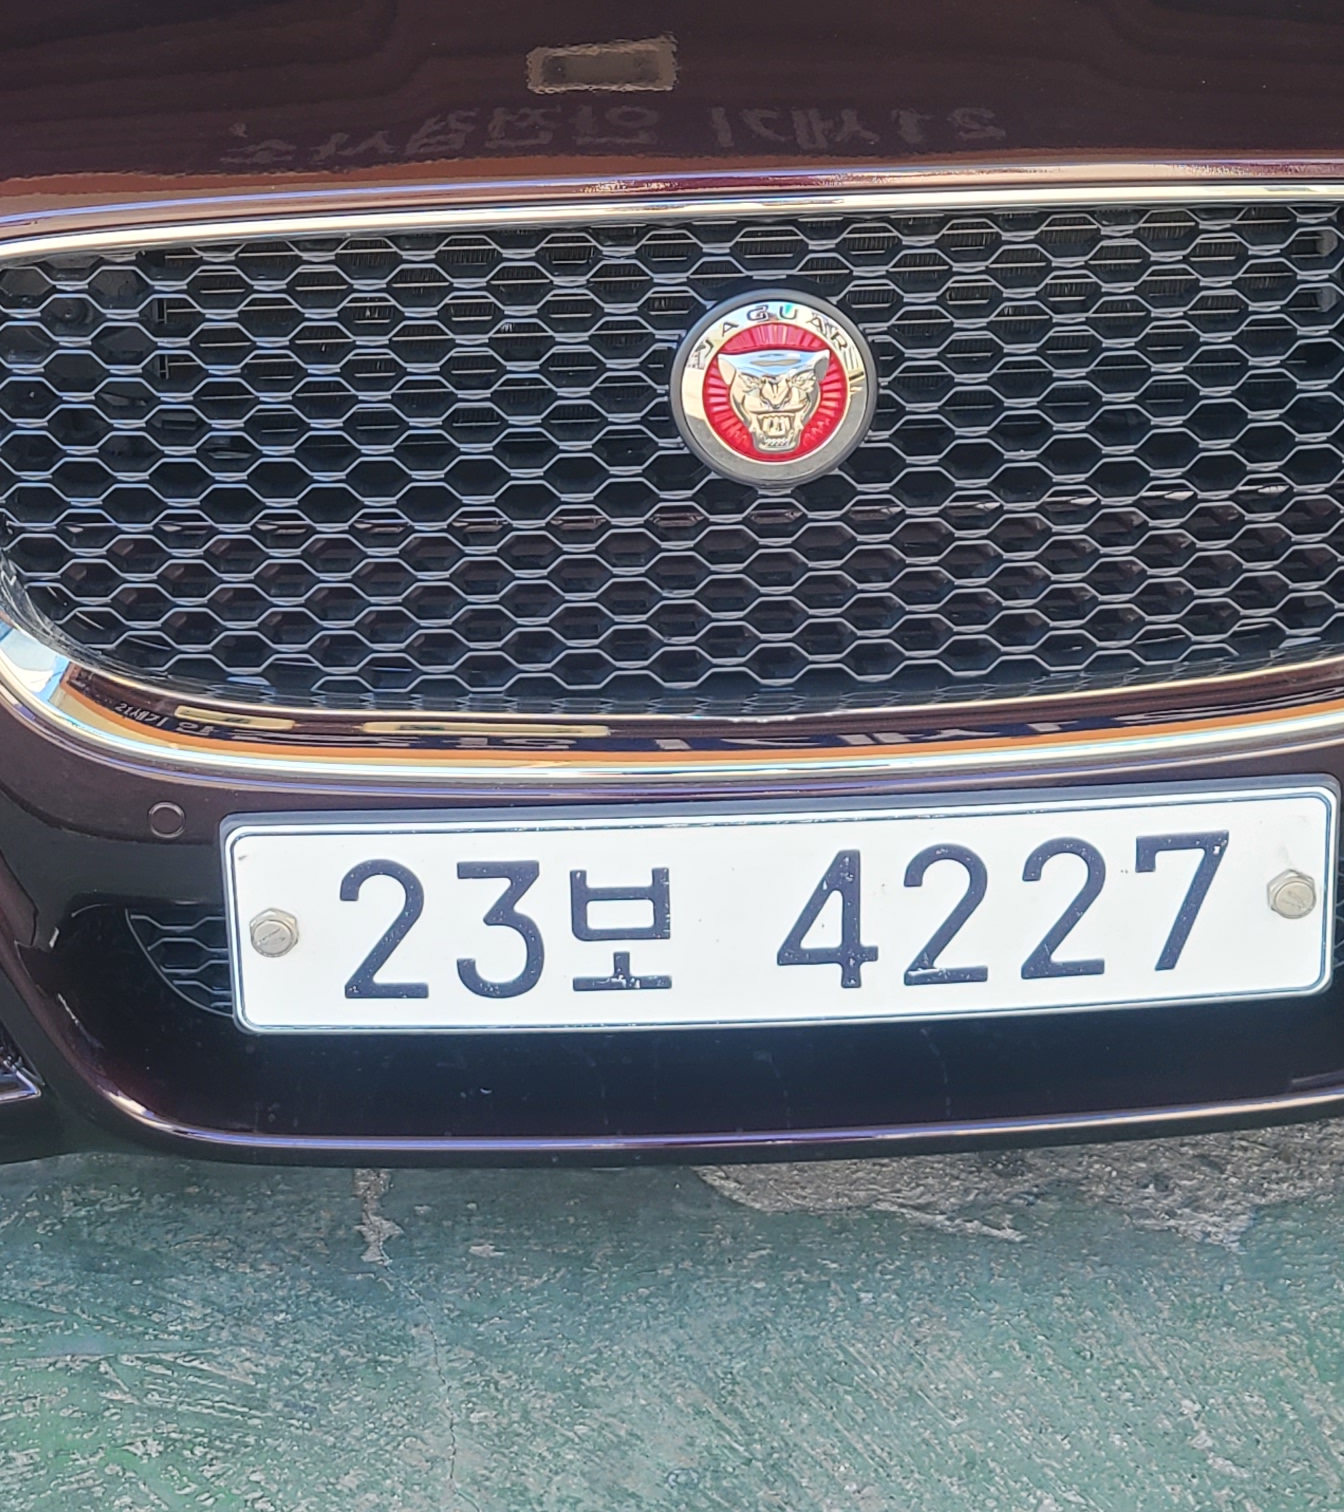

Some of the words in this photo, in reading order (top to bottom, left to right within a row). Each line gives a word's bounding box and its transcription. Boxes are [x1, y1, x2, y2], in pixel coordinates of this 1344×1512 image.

[699, 303, 849, 358] JAGUAR
[338, 858, 673, 1001] 23보
[776, 830, 1232, 990] 4227
